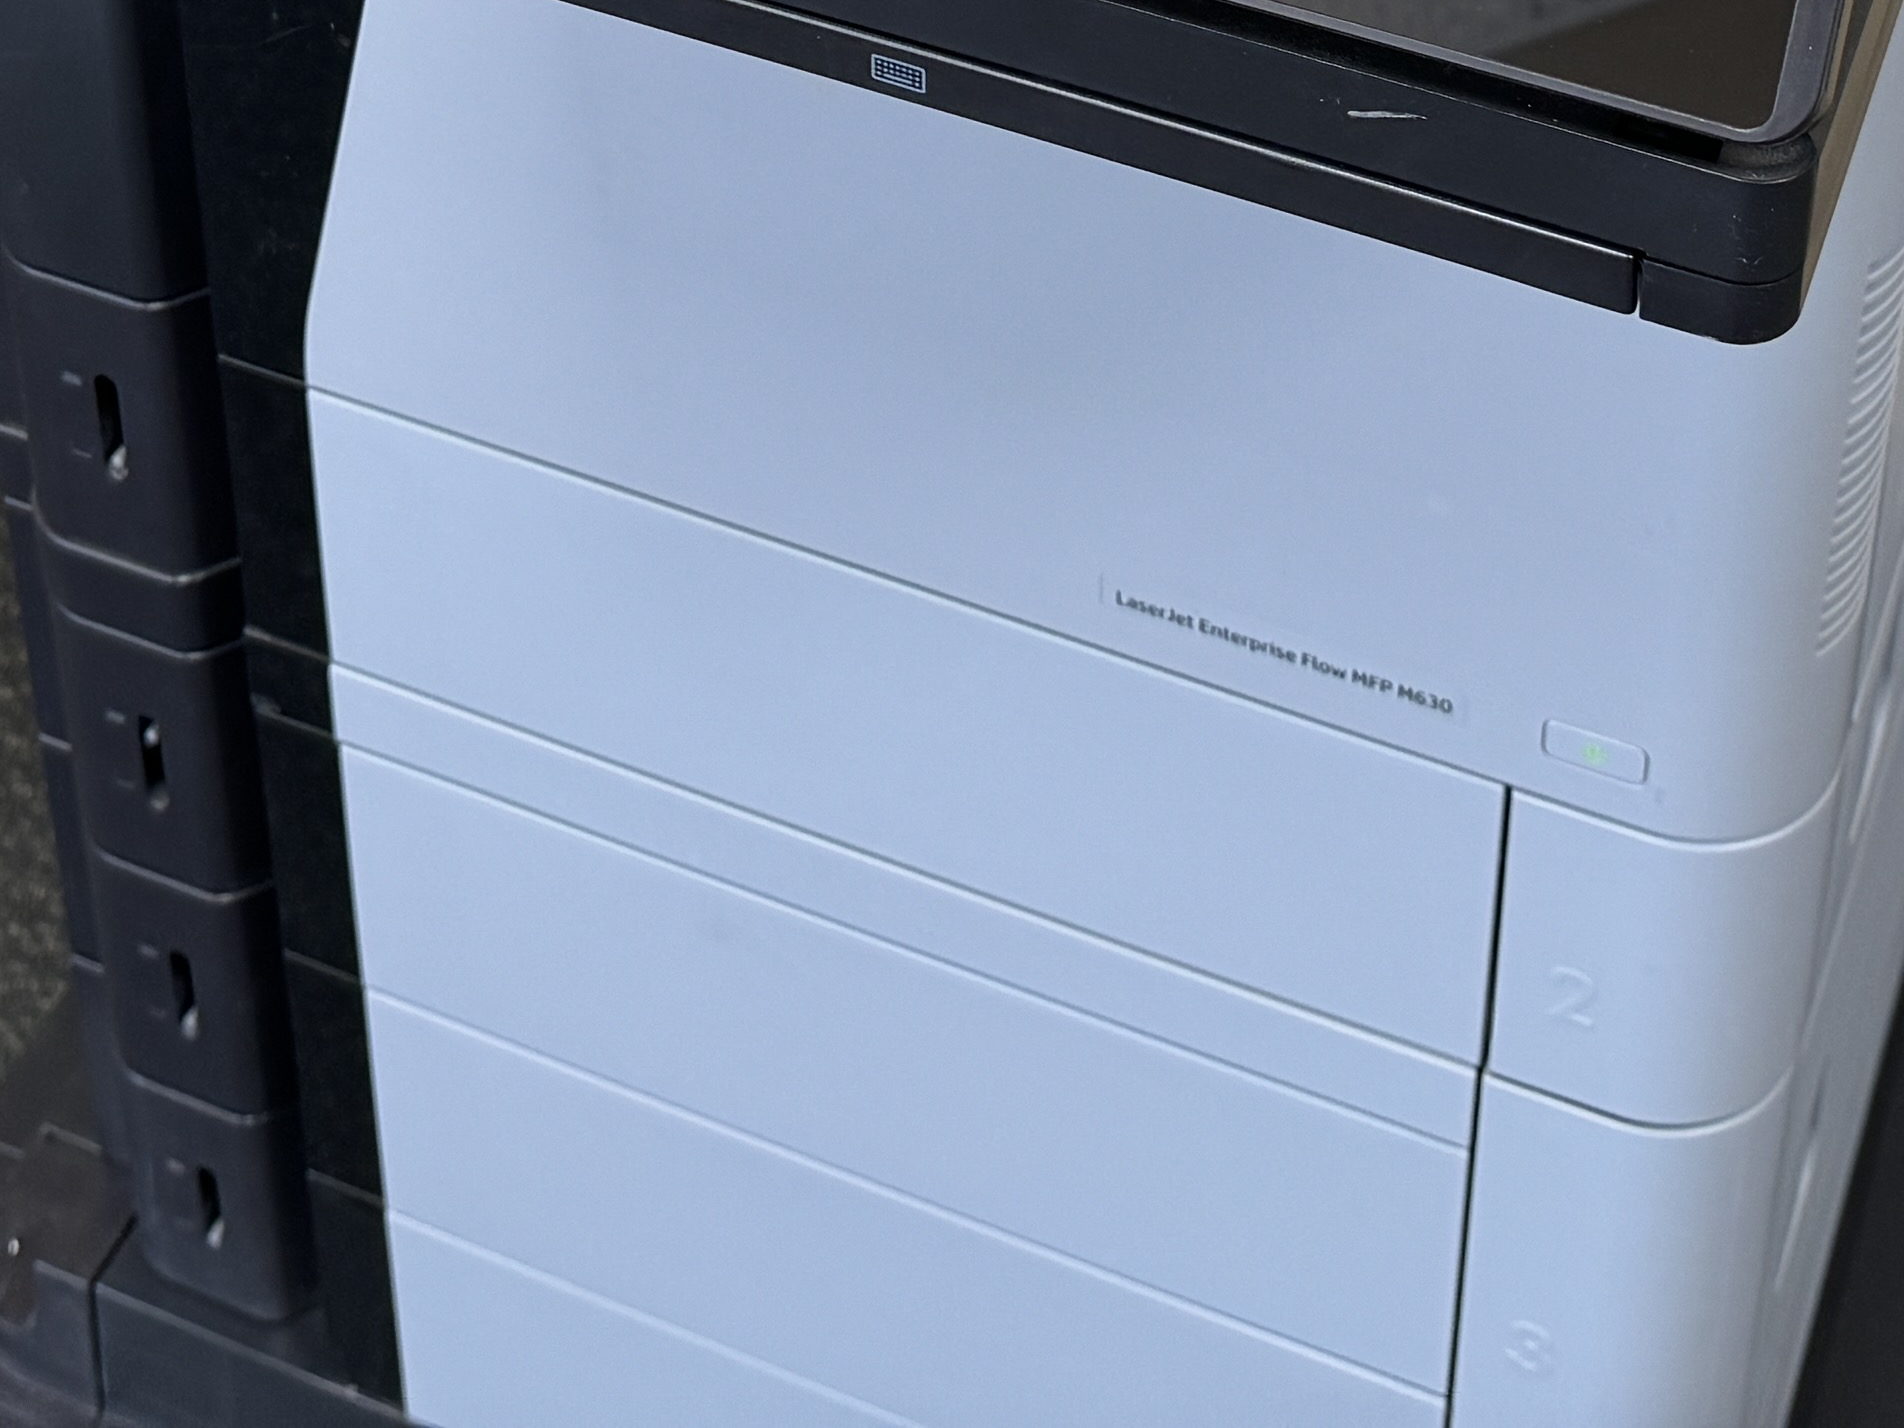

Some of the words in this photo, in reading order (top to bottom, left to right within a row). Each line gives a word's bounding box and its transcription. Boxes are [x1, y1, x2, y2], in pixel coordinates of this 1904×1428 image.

[1115, 589, 1193, 629] LaserJet
[1198, 617, 1297, 664] Enterprise
[1300, 651, 1346, 680] Flow
[1351, 668, 1393, 692] MFP
[1397, 683, 1453, 714] M630
[1547, 965, 1596, 1028] 2
[1503, 1319, 1551, 1373] 3
